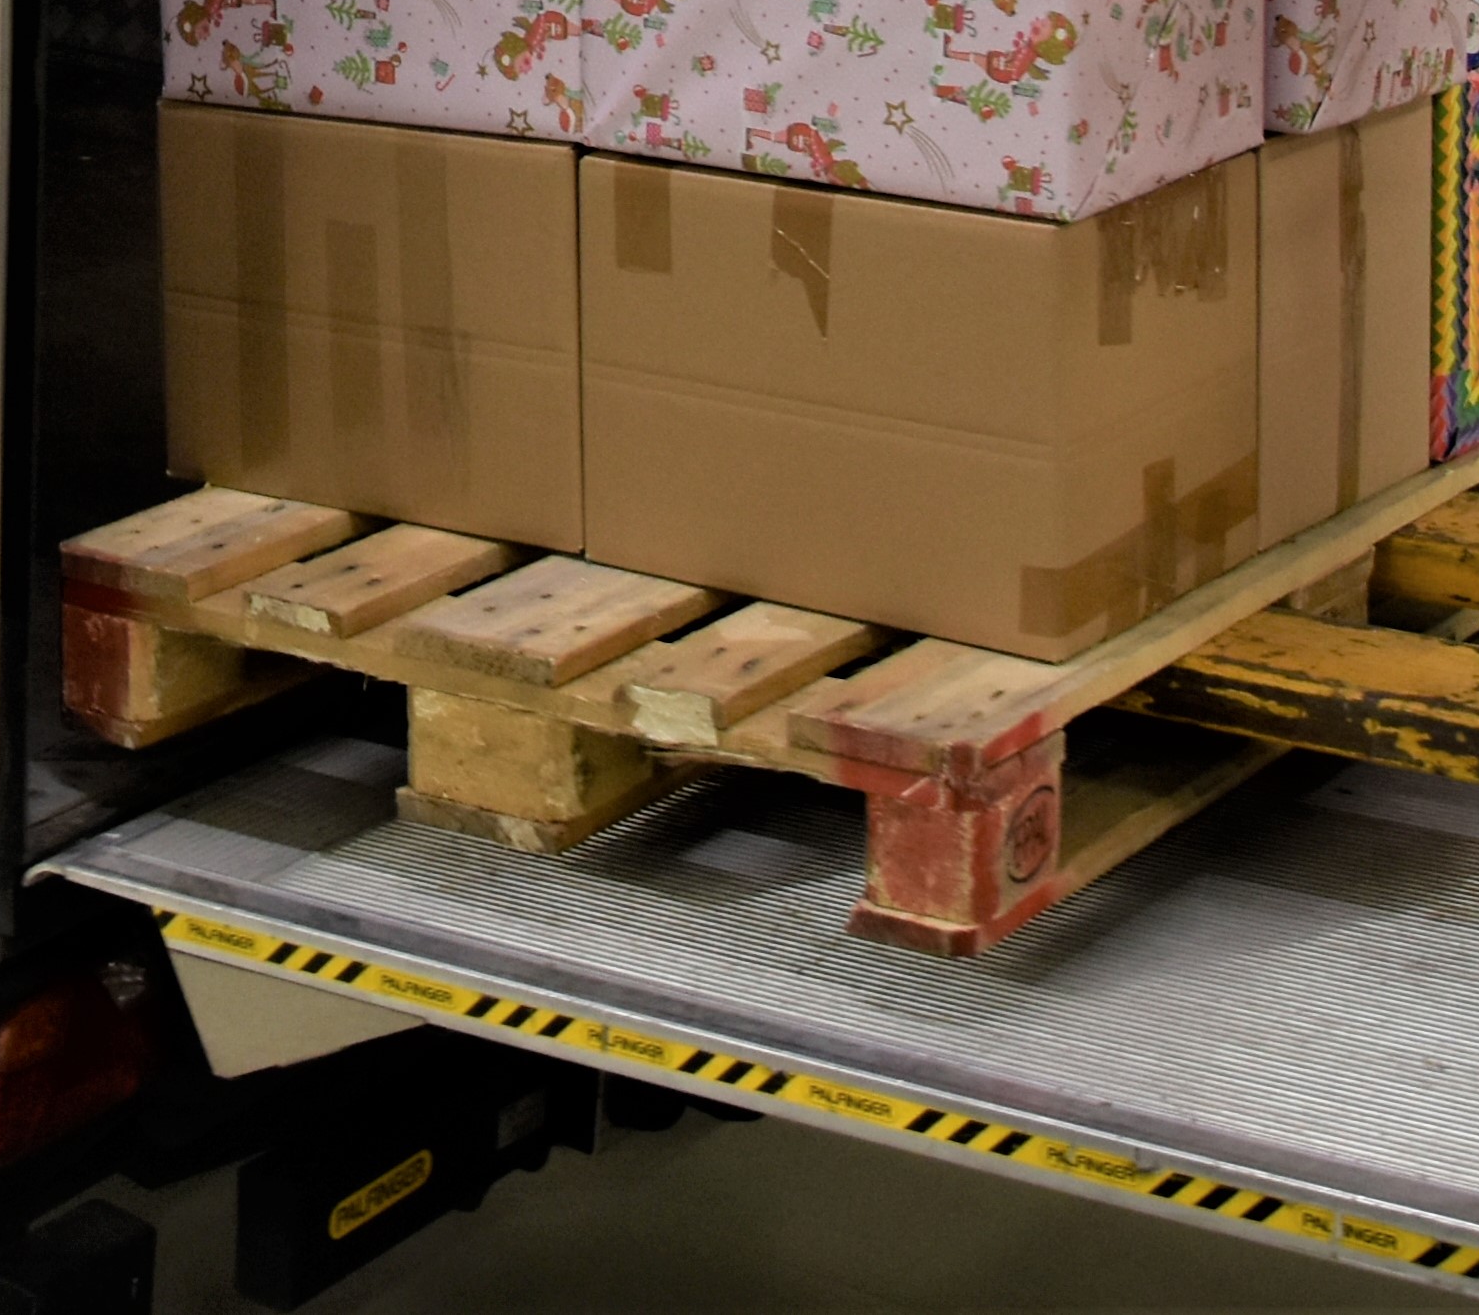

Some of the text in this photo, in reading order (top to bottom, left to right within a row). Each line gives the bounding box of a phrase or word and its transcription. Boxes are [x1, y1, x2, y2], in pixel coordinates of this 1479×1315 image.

[189, 922, 254, 950] PALFINGER
[380, 974, 453, 1003] PALFINGER
[808, 1084, 893, 1117] PALFINGER
[1046, 1146, 1135, 1182] PALFINGER
[1301, 1211, 1398, 1250] PALINGER
